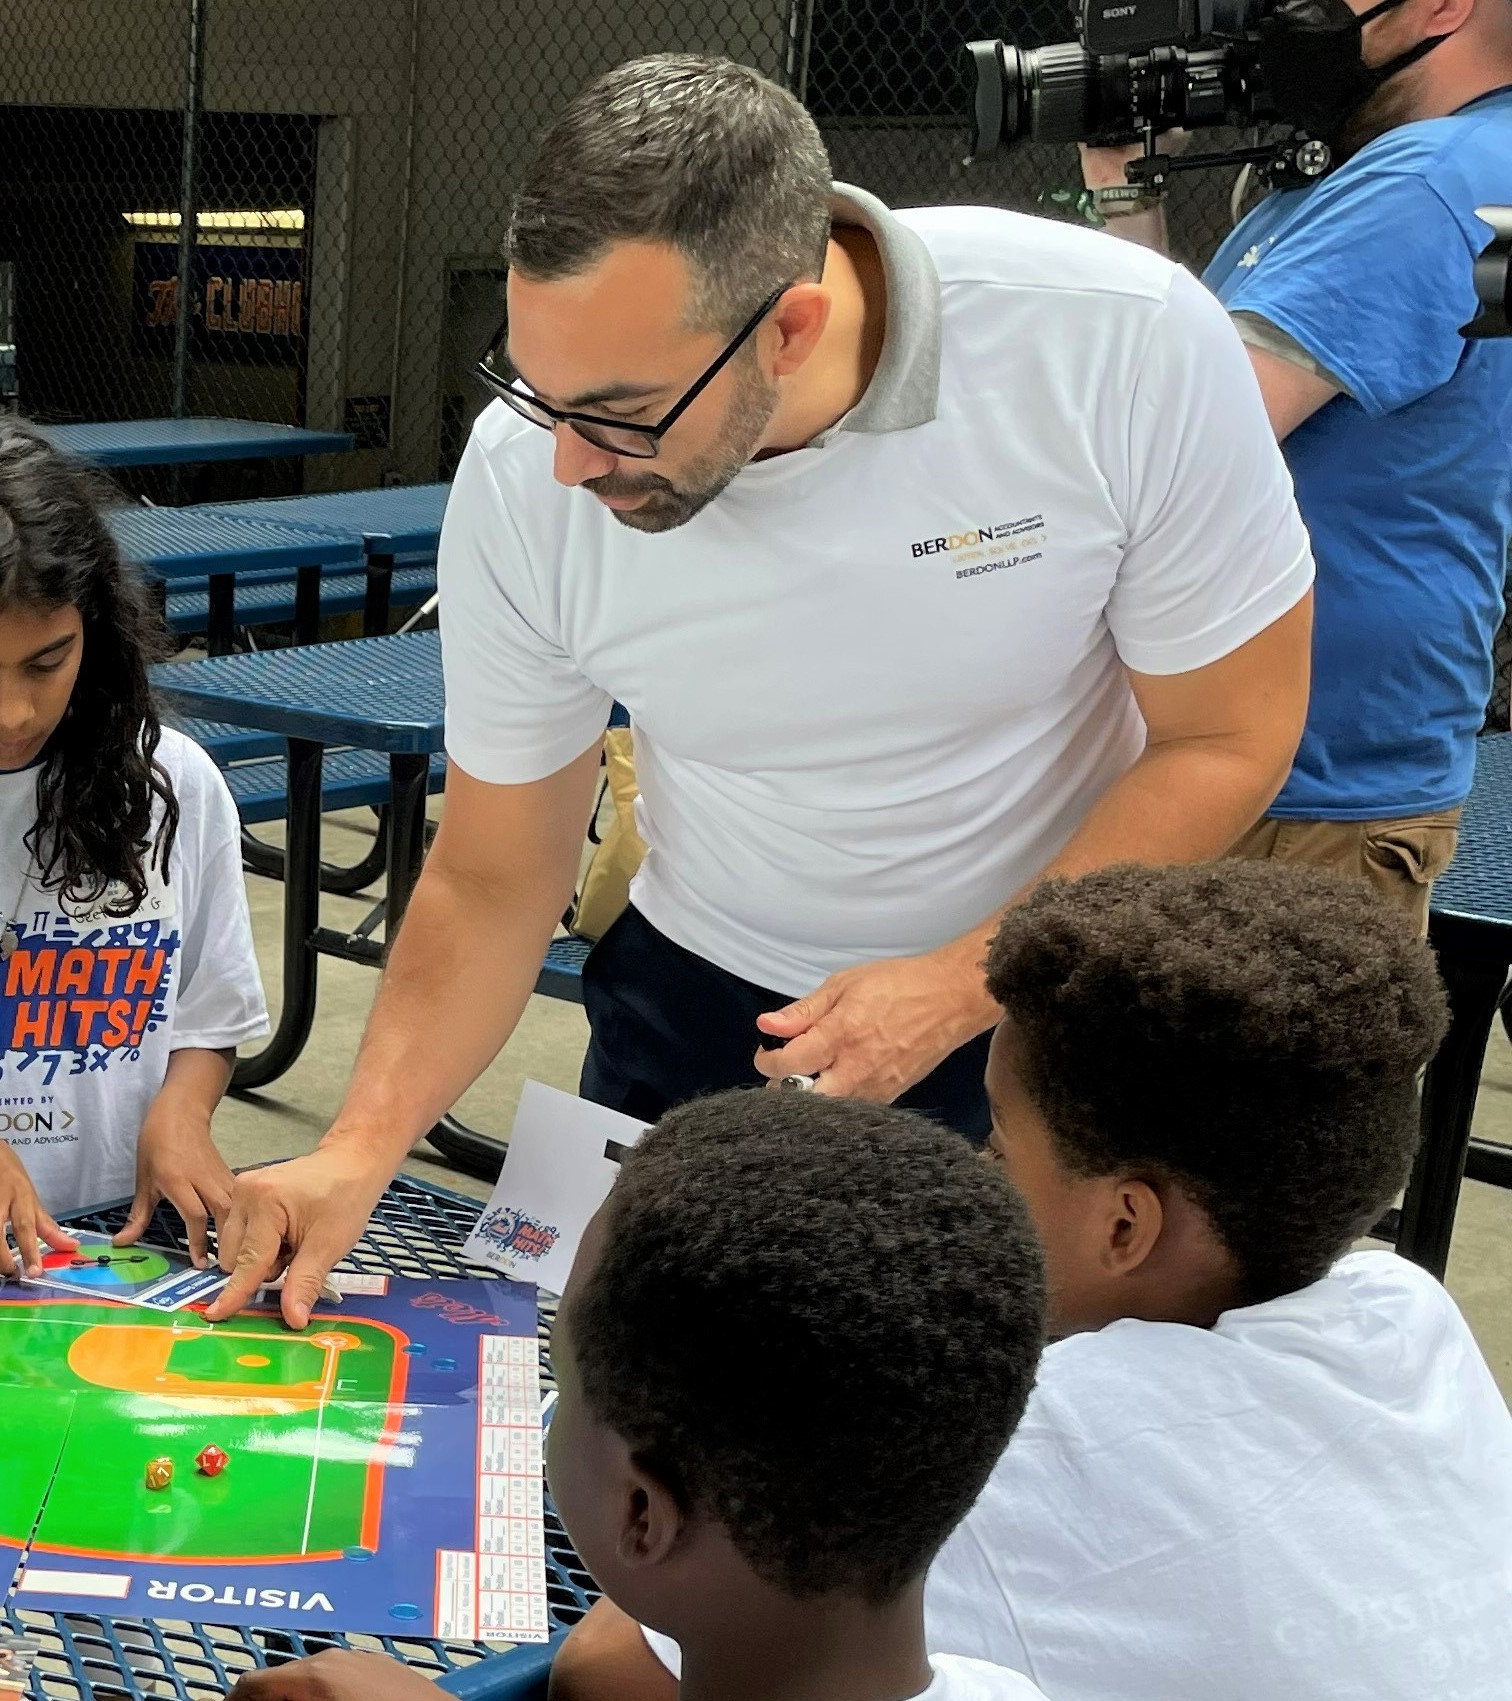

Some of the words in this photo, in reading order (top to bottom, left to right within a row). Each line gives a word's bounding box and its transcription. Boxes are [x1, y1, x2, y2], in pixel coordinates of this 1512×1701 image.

[1103, 5, 1137, 19] SONY
[911, 526, 994, 559] BERDON
[4, 948, 166, 998] MATH
[11, 1000, 153, 1049] HITS!
[41, 1096, 55, 1104] BY
[11, 1137, 32, 1146] AND
[147, 1579, 335, 1612] VISITOR
[486, 1631, 543, 1640] VISITOR
